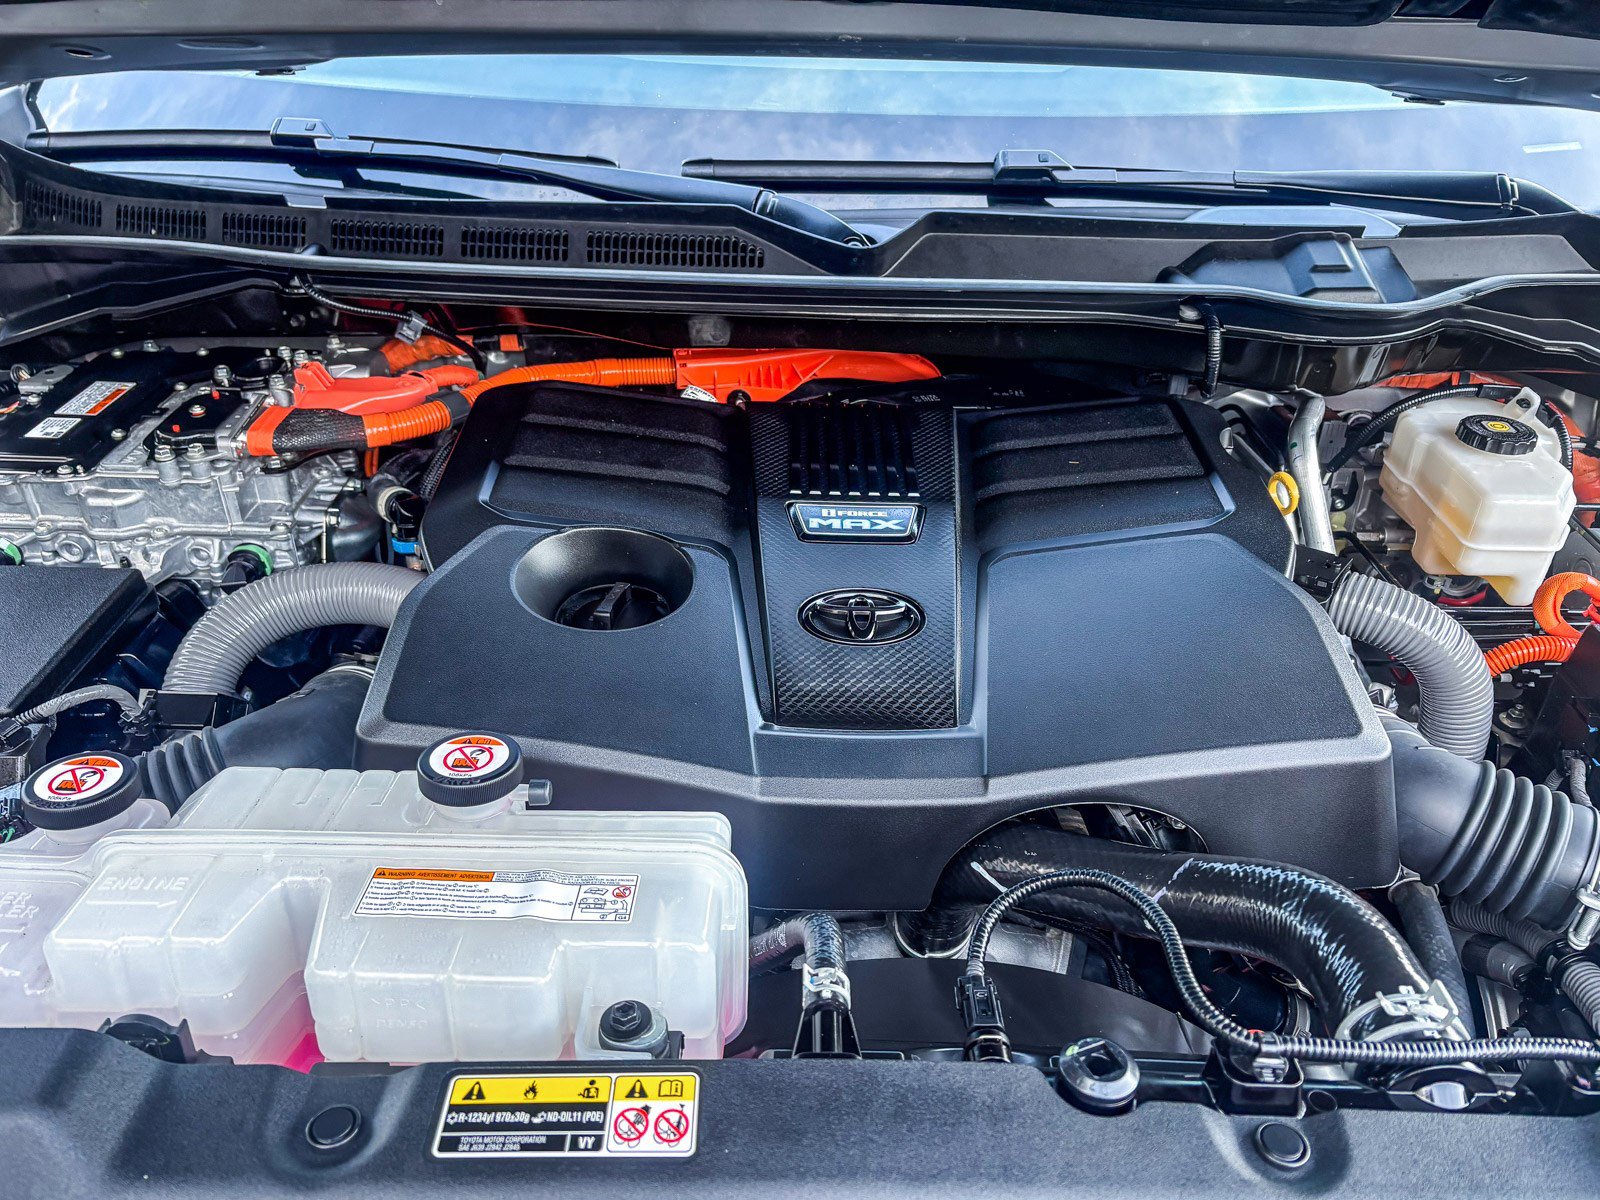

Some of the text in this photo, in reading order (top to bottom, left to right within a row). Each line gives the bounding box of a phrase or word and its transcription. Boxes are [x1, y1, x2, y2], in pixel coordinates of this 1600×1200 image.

[809, 517, 906, 530] MAX
[546, 1110, 582, 1122] ND-OIL11
[582, 1110, 605, 1124] (POE)
[460, 1135, 547, 1144] TOYOTA MOTOR CORPORATION
[578, 1136, 596, 1149] VY
[457, 1144, 470, 1152] SAE
